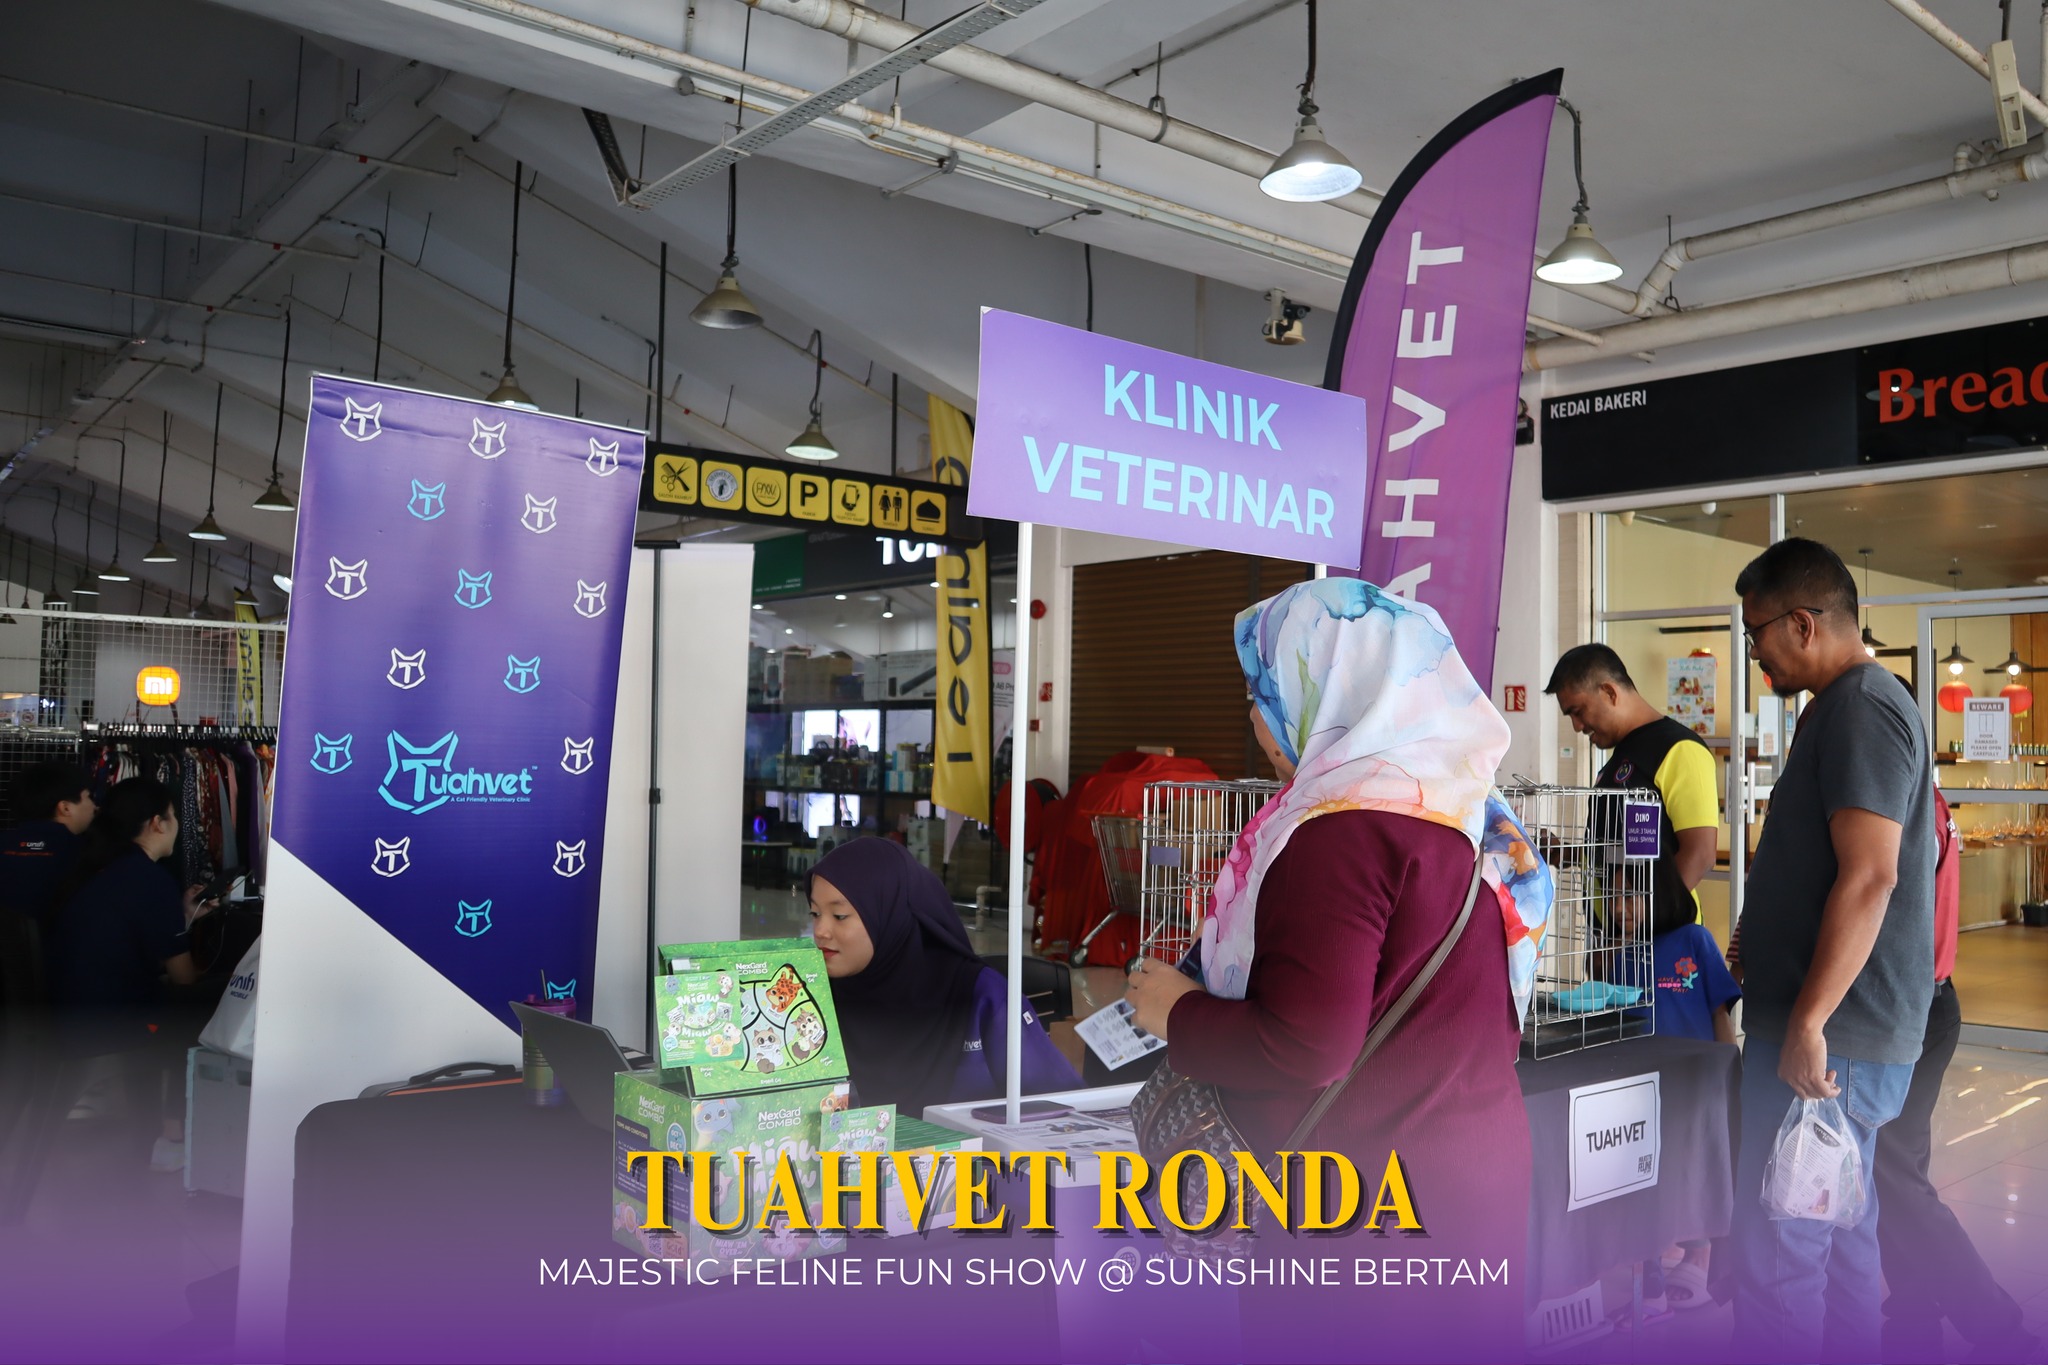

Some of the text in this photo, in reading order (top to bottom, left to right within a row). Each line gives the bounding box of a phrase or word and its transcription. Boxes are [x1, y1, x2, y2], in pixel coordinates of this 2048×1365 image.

[1104, 364, 1282, 451] KLINIK
[1550, 390, 1647, 419] KEDAI BAKERI
[800, 480, 818, 507] P
[1023, 435, 1335, 538] VETERINAR
[1971, 703, 2002, 711] BEWARE
[401, 759, 532, 802] Tuahvet
[1635, 812, 1650, 823] DINO
[638, 1095, 665, 1115] NexGard
[638, 1108, 665, 1125] COMBO
[758, 1107, 801, 1122] NexGard
[757, 1117, 801, 1131] COMBO
[1586, 1120, 1646, 1153] TUAH VET
